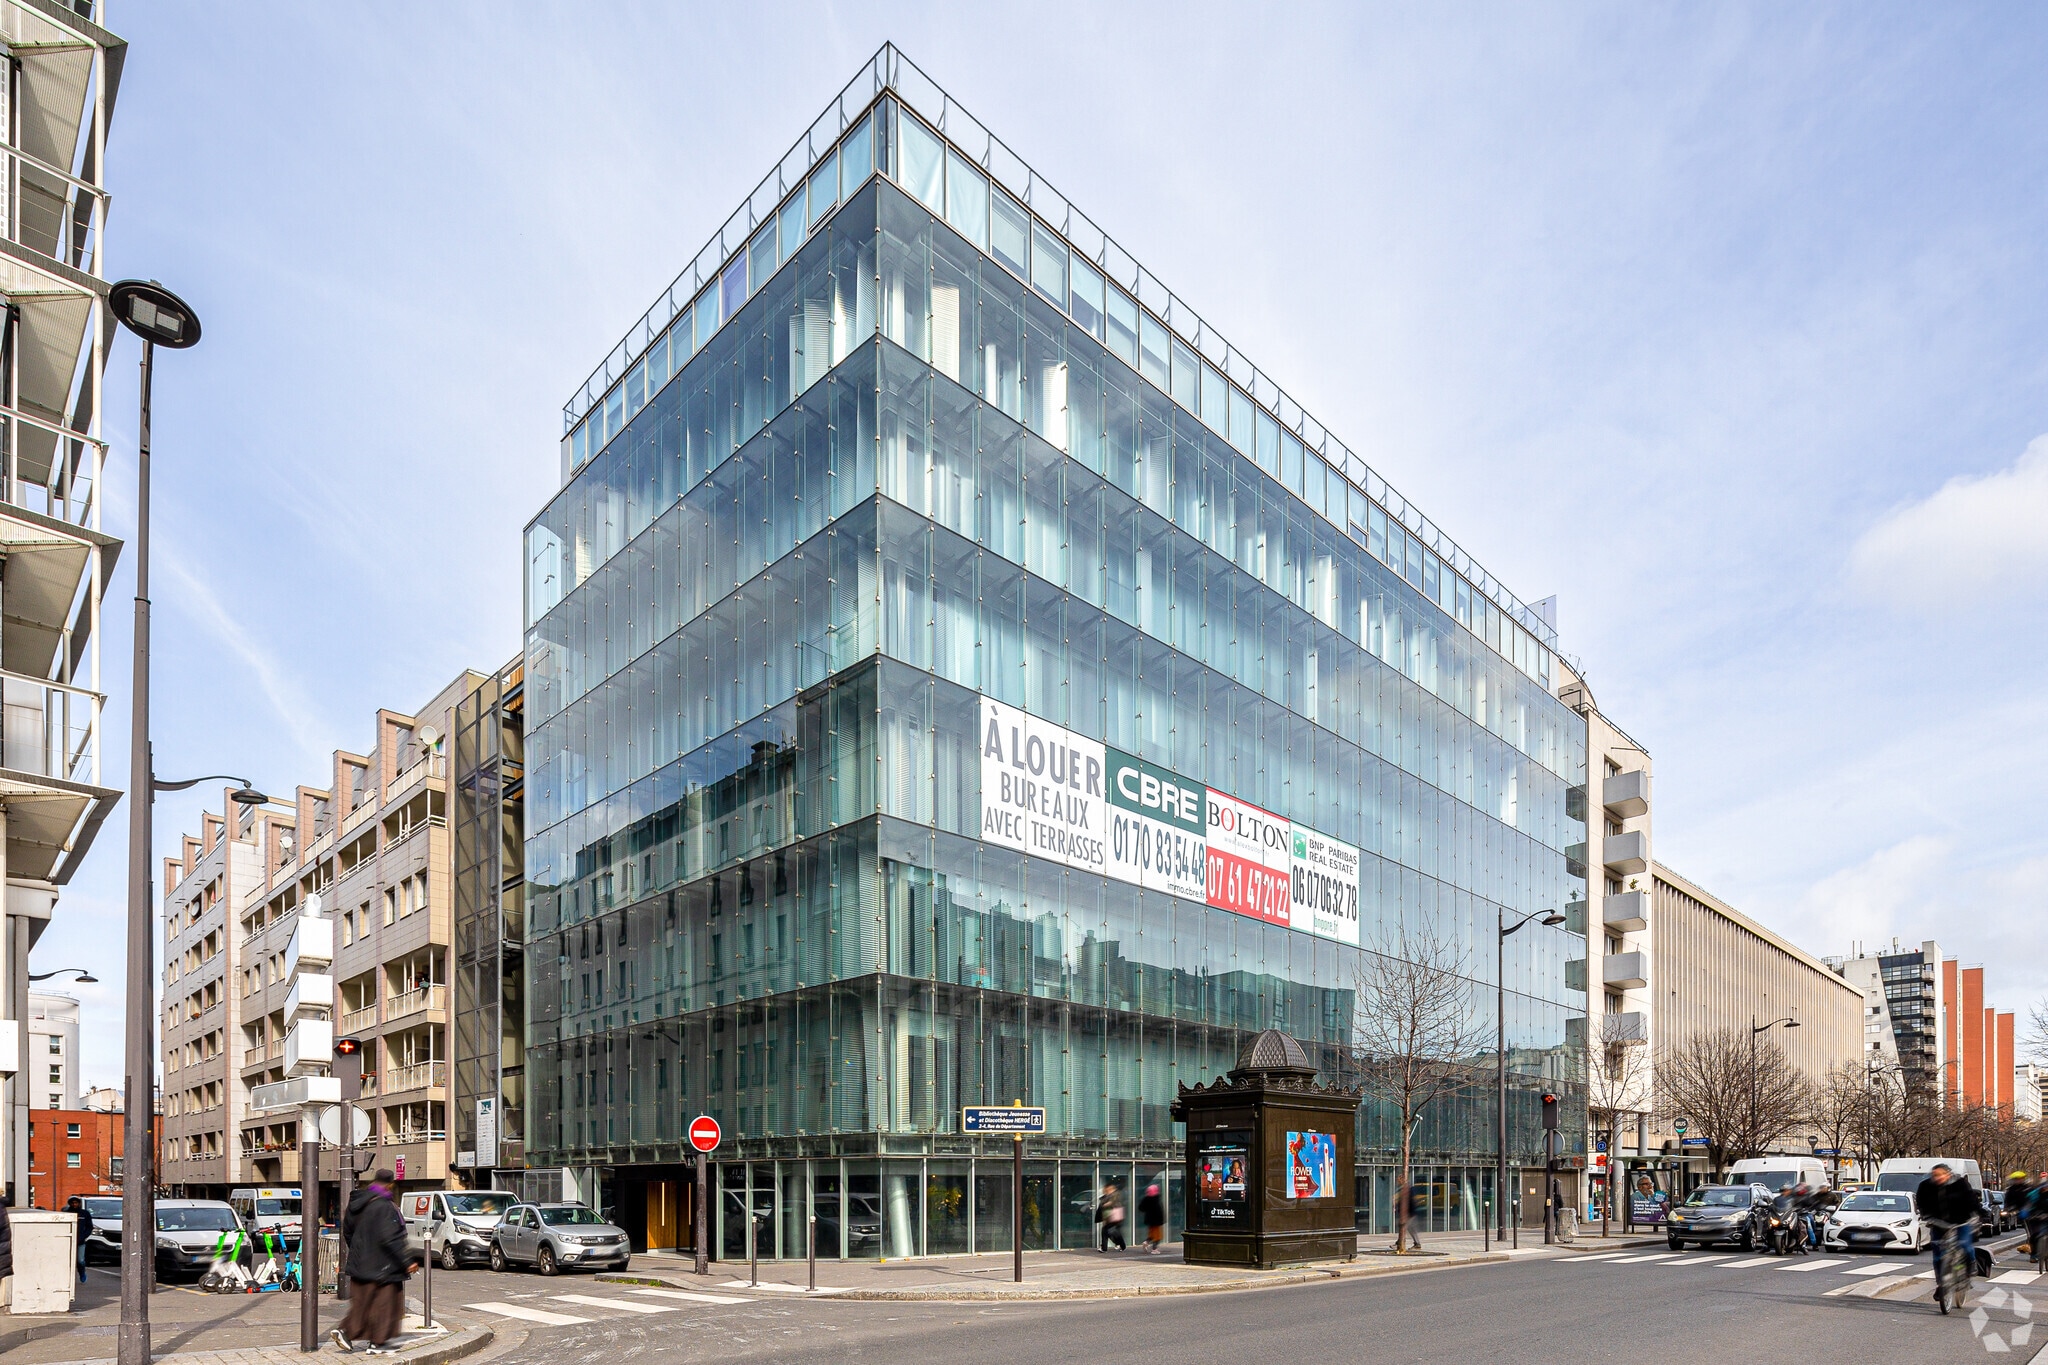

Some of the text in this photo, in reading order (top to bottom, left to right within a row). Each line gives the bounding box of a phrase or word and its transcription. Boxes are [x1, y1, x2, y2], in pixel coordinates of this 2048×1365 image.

[984, 705, 1101, 798] À LOUER
[1001, 771, 1089, 829] BUREAUX
[1117, 766, 1199, 824] CBRE
[984, 806, 1104, 865] AVEC TERRASSES
[1208, 801, 1289, 853] BOLTON
[1309, 838, 1357, 866] BNP PARIBAS
[1208, 854, 1224, 900] 07
[1228, 861, 1242, 906] 61
[1309, 851, 1354, 876] REAL ESTATE
[1167, 880, 1206, 900] immo.cbre.fr
[1216, 1208, 1235, 1216] TikTok
